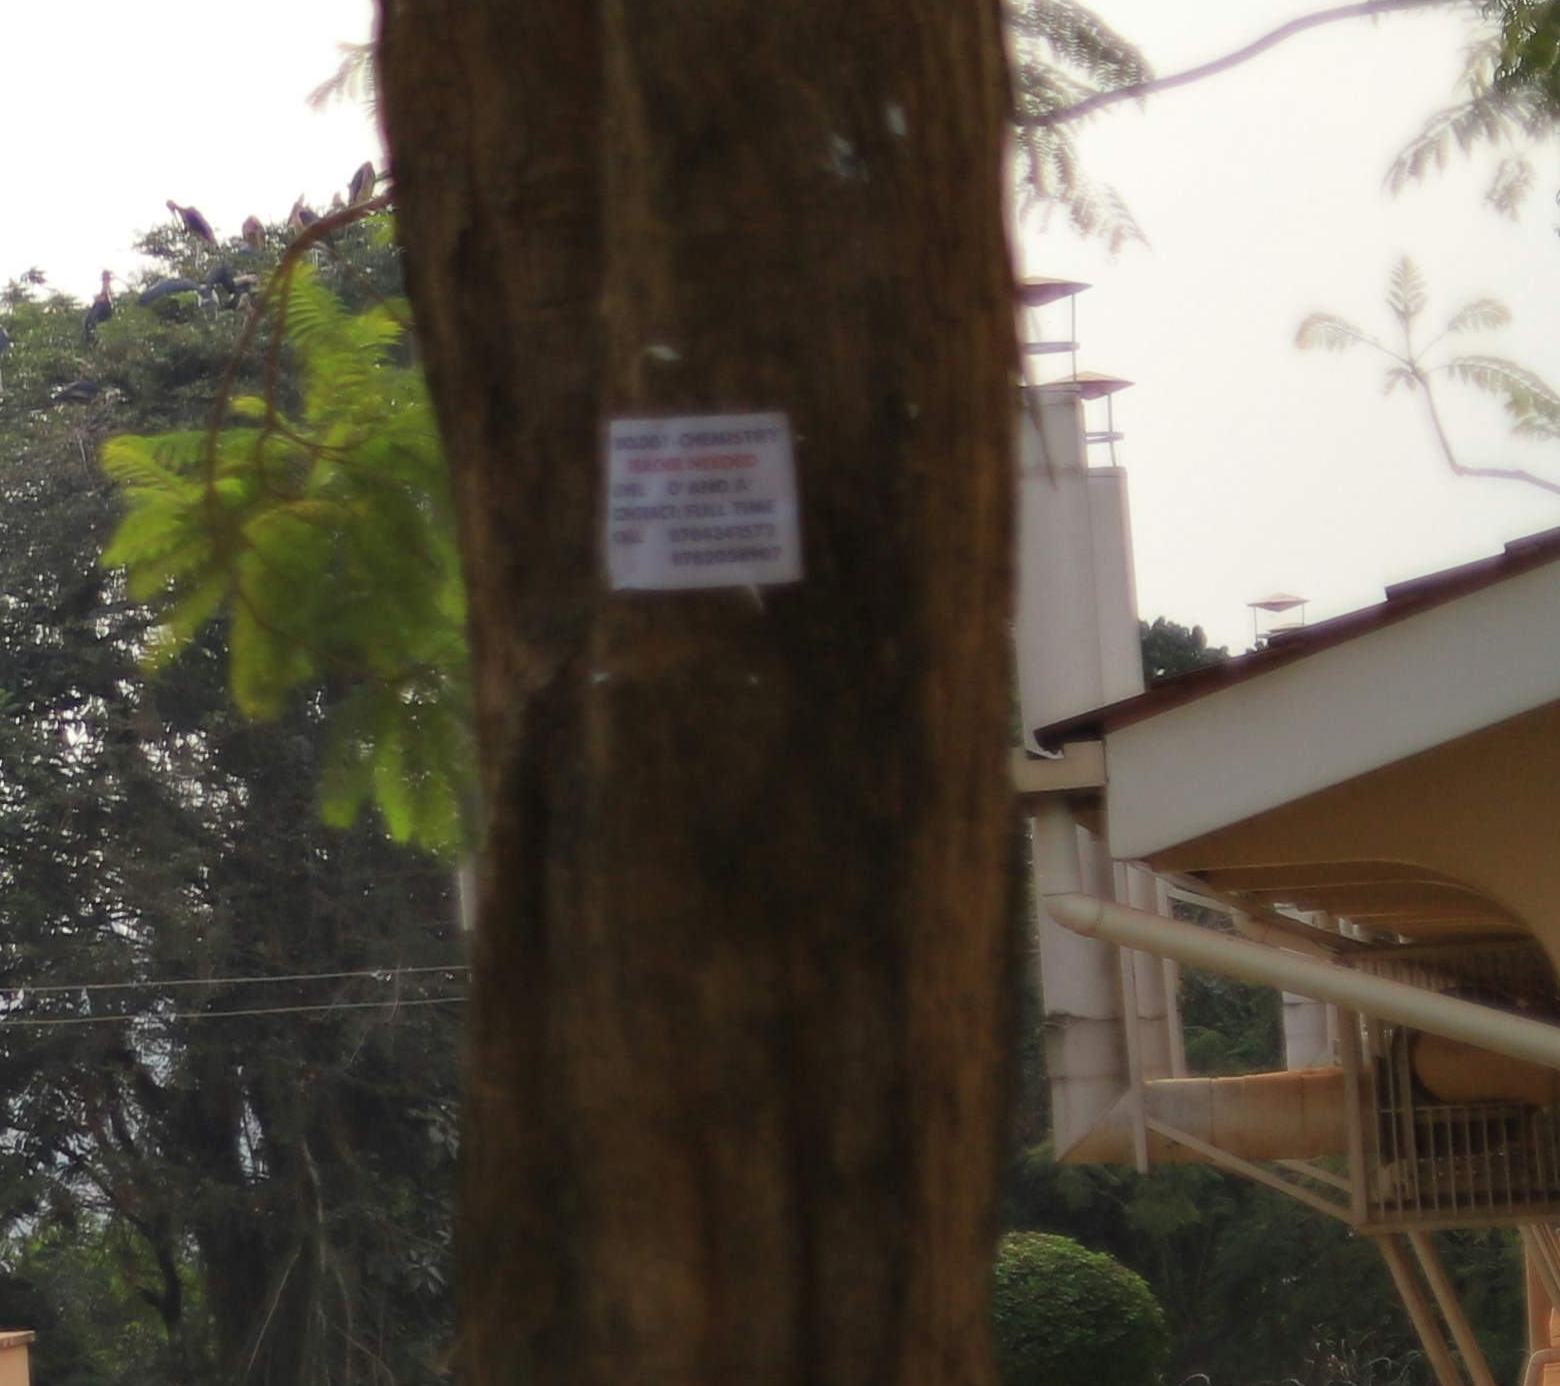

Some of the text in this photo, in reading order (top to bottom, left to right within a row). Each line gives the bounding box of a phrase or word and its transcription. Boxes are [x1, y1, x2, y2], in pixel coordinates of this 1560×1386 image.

[679, 427, 780, 447] CHEMISTRY
[686, 454, 757, 471] NEEDED
[687, 479, 730, 494] AND
[684, 504, 726, 519] FULL
[732, 499, 776, 516] TIME
